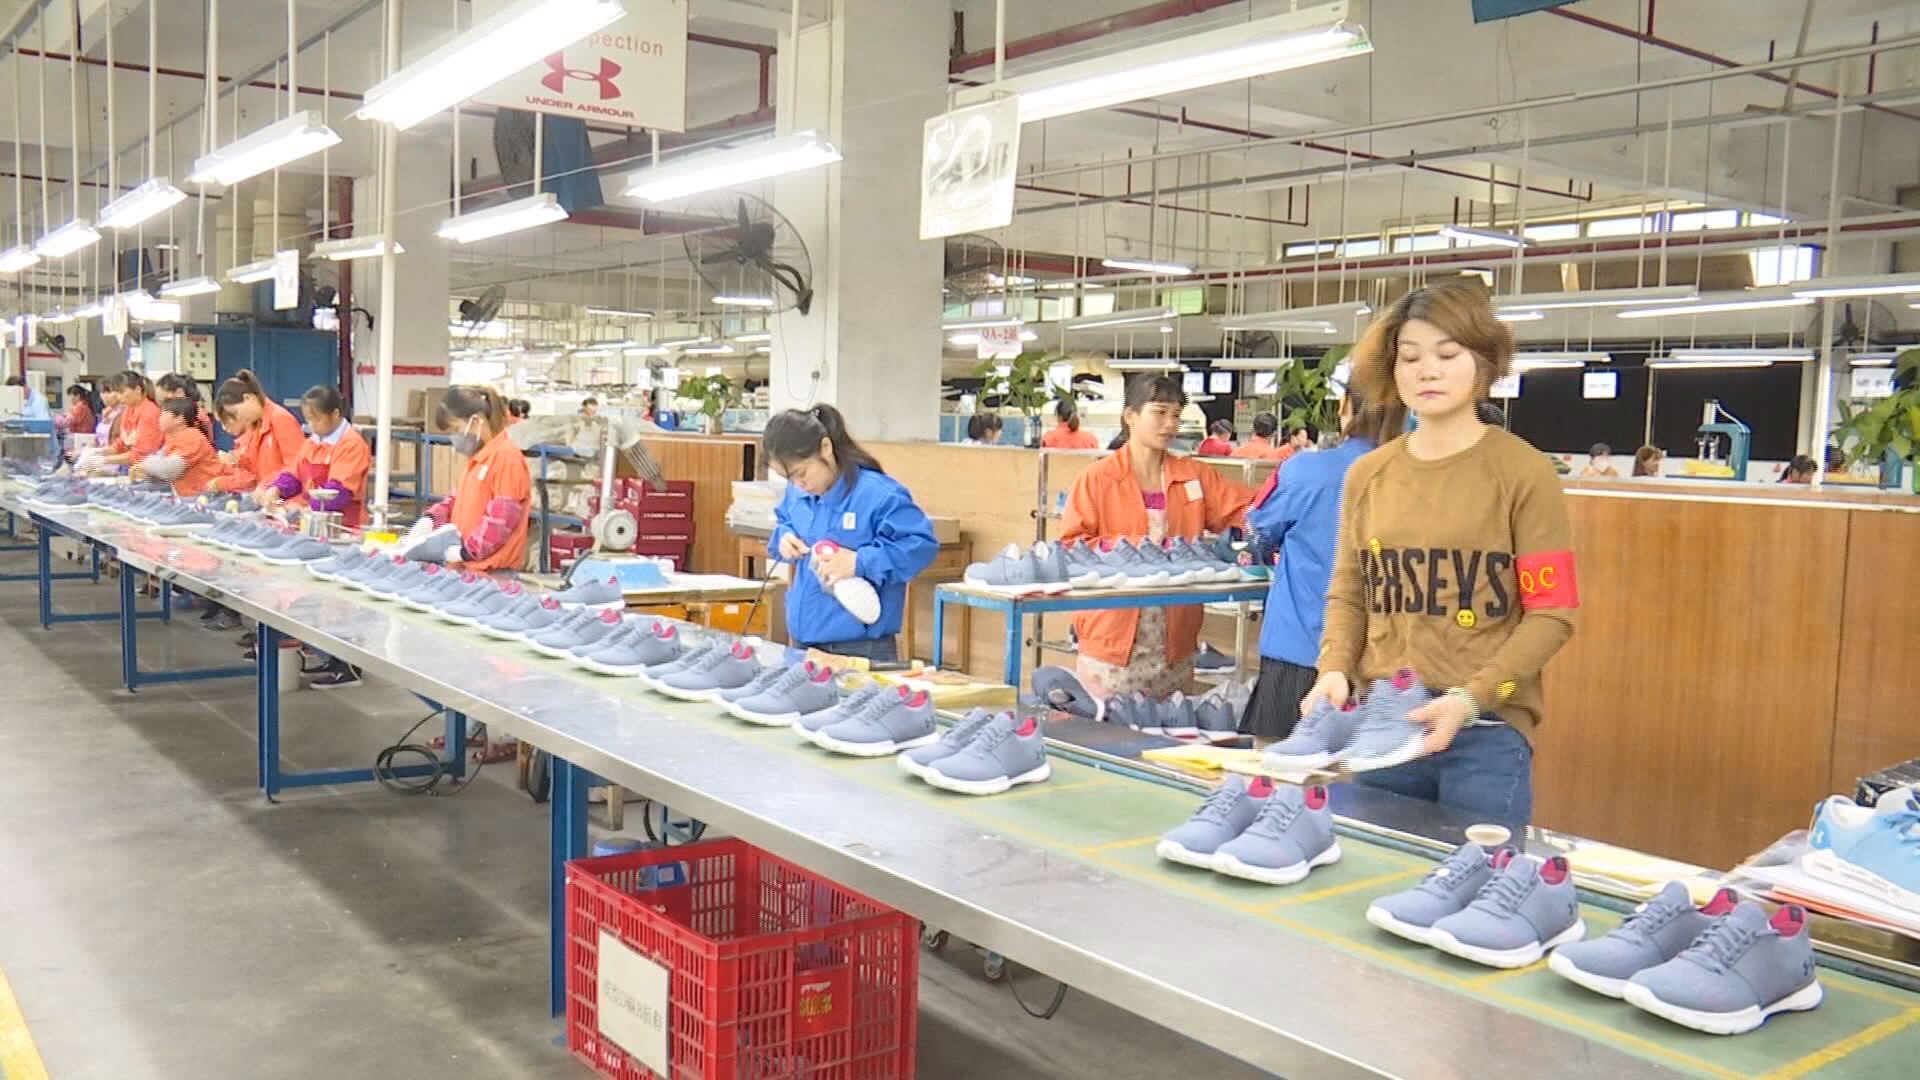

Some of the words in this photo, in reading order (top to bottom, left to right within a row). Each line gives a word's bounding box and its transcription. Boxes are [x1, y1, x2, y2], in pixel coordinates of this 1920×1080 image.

[588, 31, 664, 57] pection
[525, 95, 573, 110] UNDER
[577, 103, 635, 119] ARMOUR
[1520, 565, 1557, 594] QC
